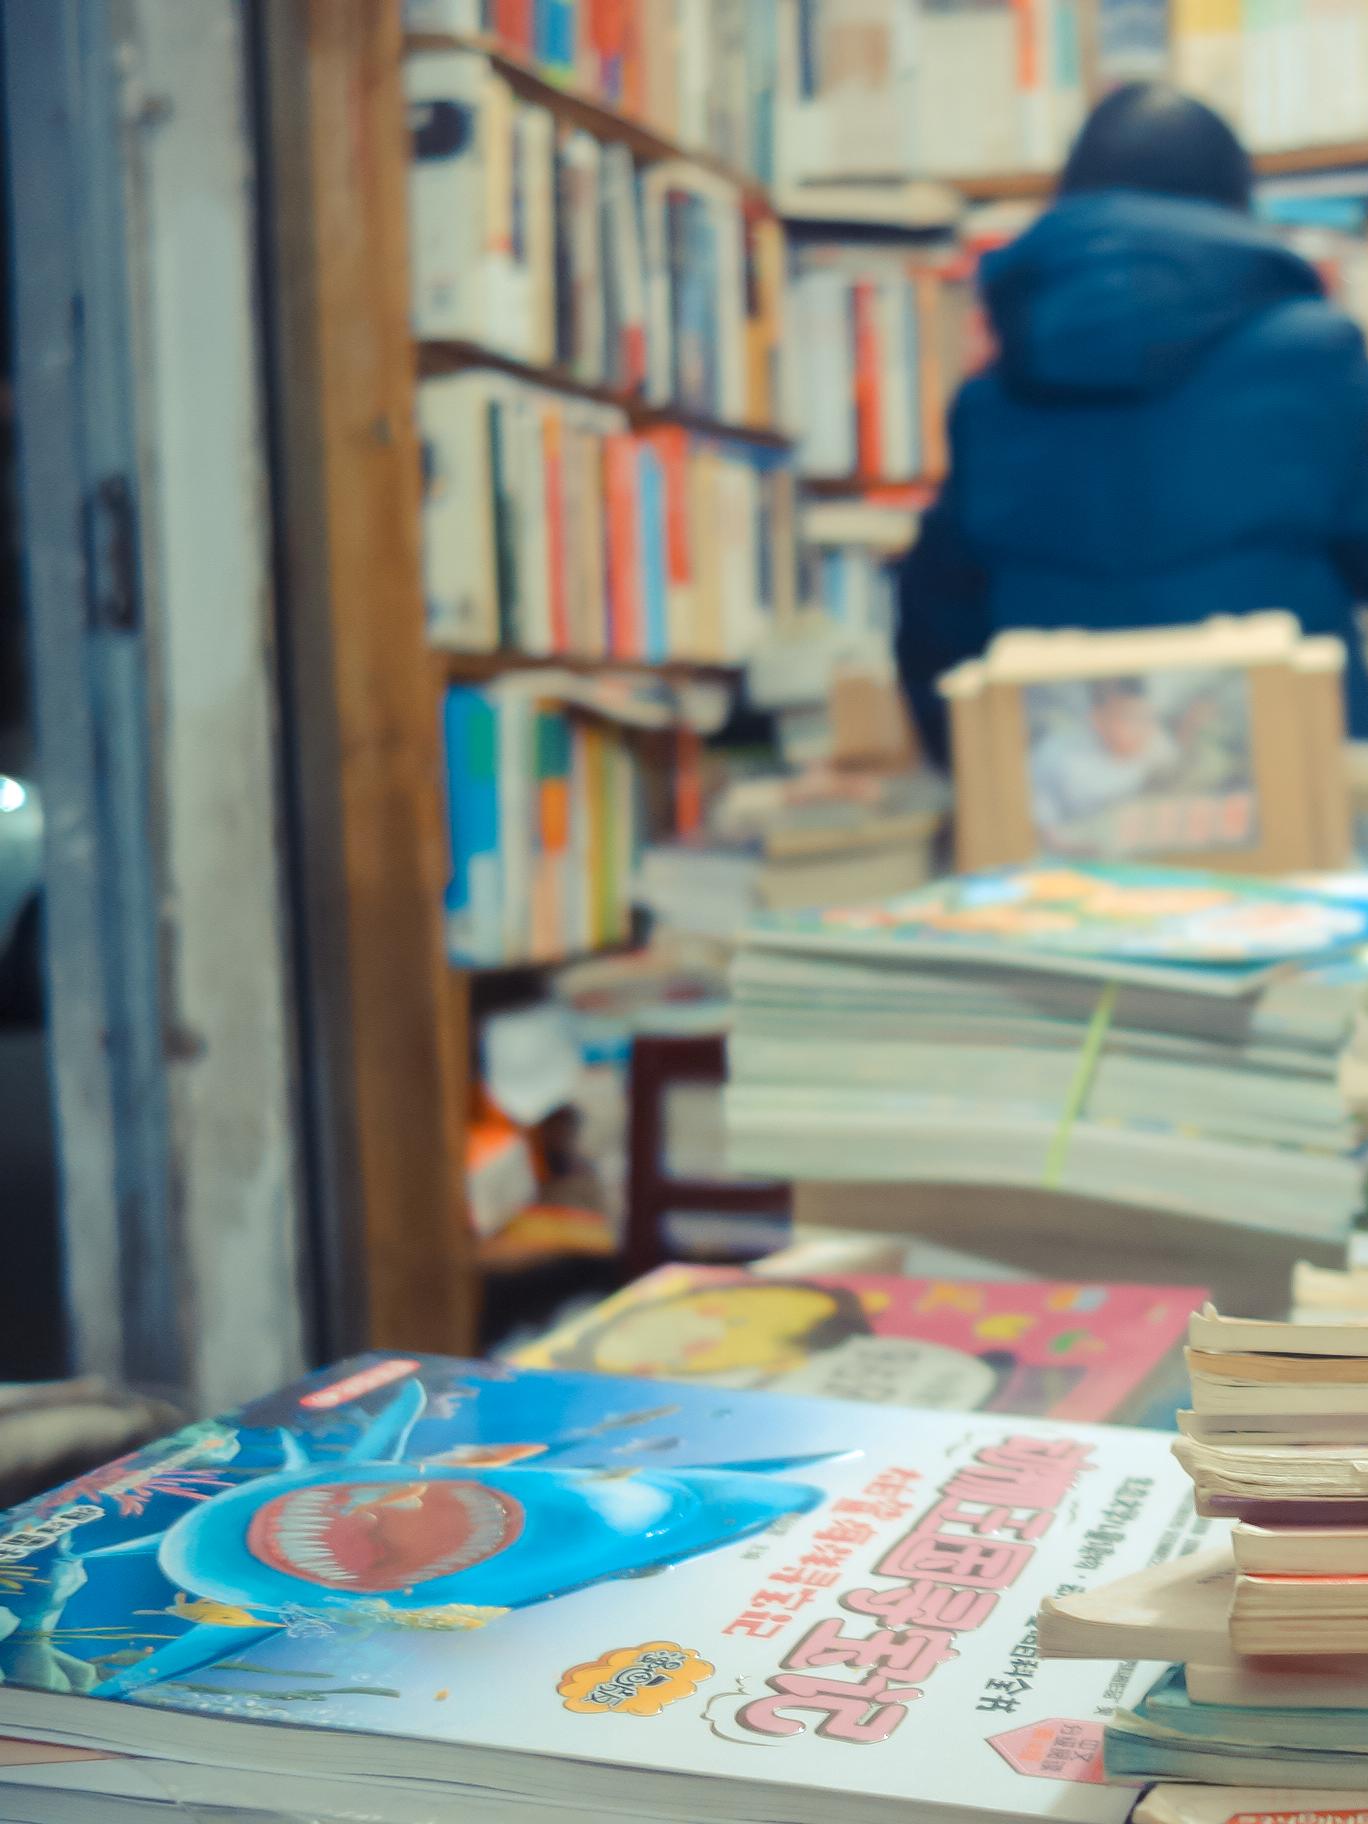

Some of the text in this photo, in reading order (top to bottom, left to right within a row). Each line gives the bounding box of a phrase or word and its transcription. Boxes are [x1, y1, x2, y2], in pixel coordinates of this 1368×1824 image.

[735, 1433, 1100, 1744] 动物王国寻宝记
